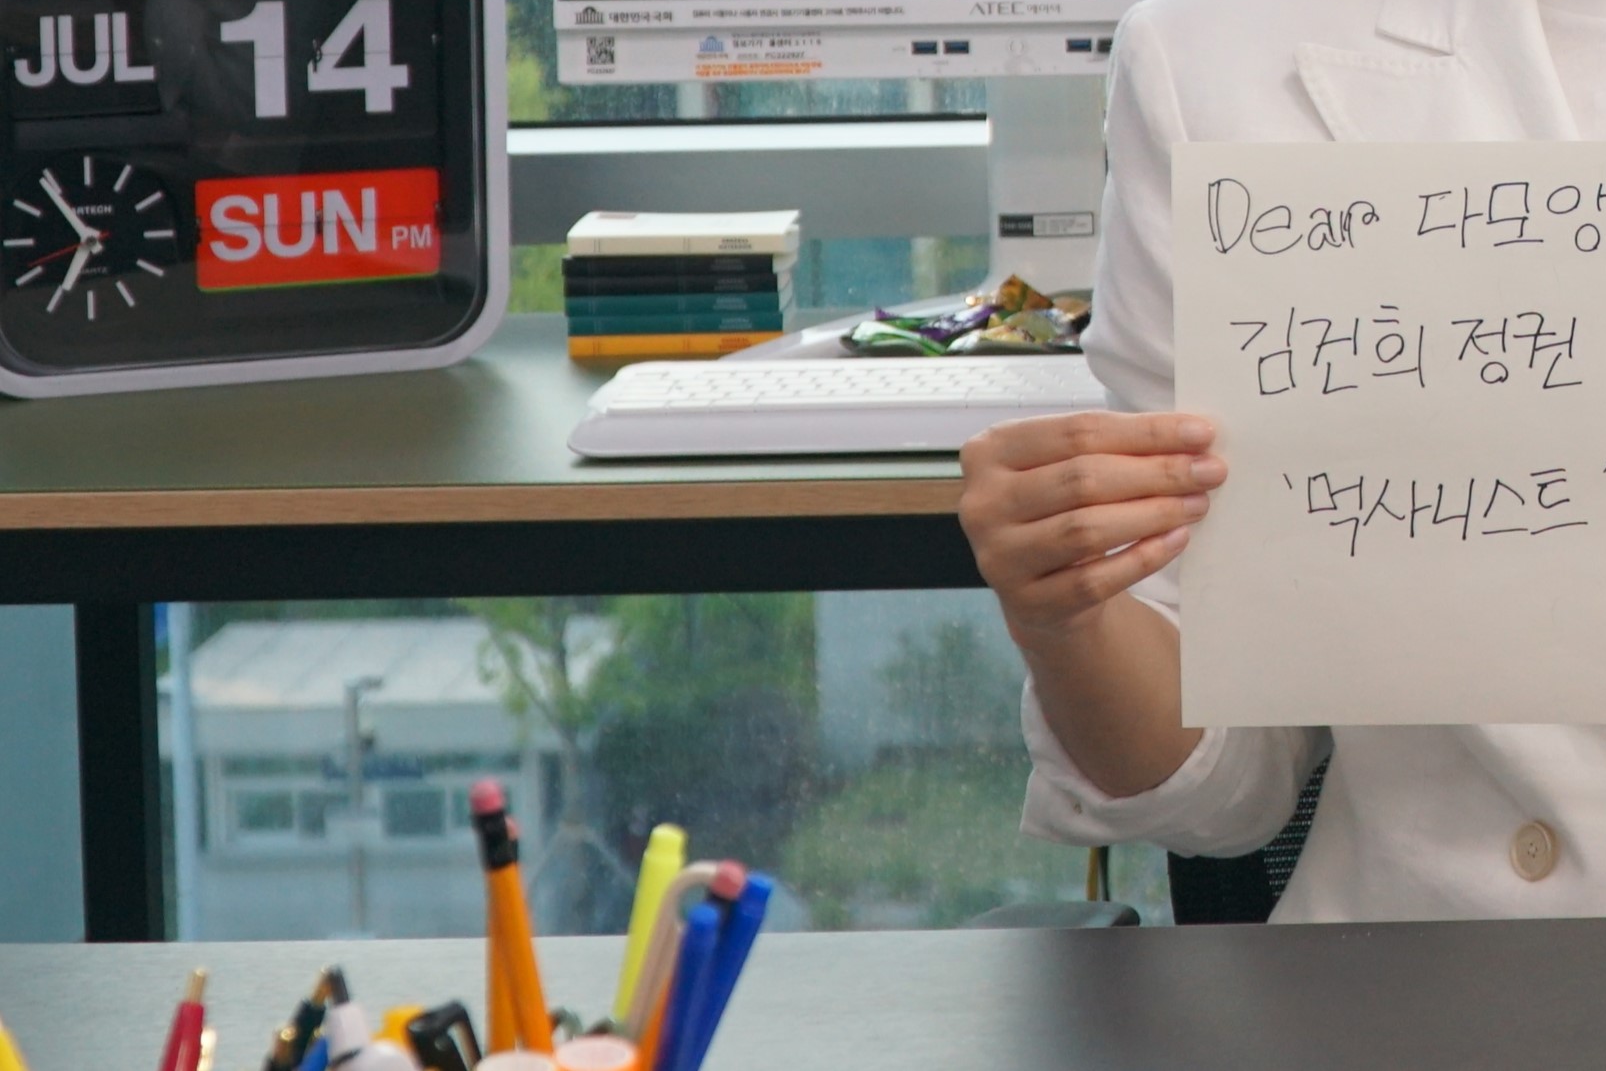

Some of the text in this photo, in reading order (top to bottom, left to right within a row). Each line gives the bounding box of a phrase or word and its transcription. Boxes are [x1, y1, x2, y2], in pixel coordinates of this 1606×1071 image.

[969, 1, 1026, 16] ATEC
[15, 12, 155, 88] JUL
[209, 187, 432, 262] SUN PM
[1207, 178, 1380, 255] Dear
[1229, 305, 1426, 396] 김건희
[1451, 310, 1584, 391] 정권
